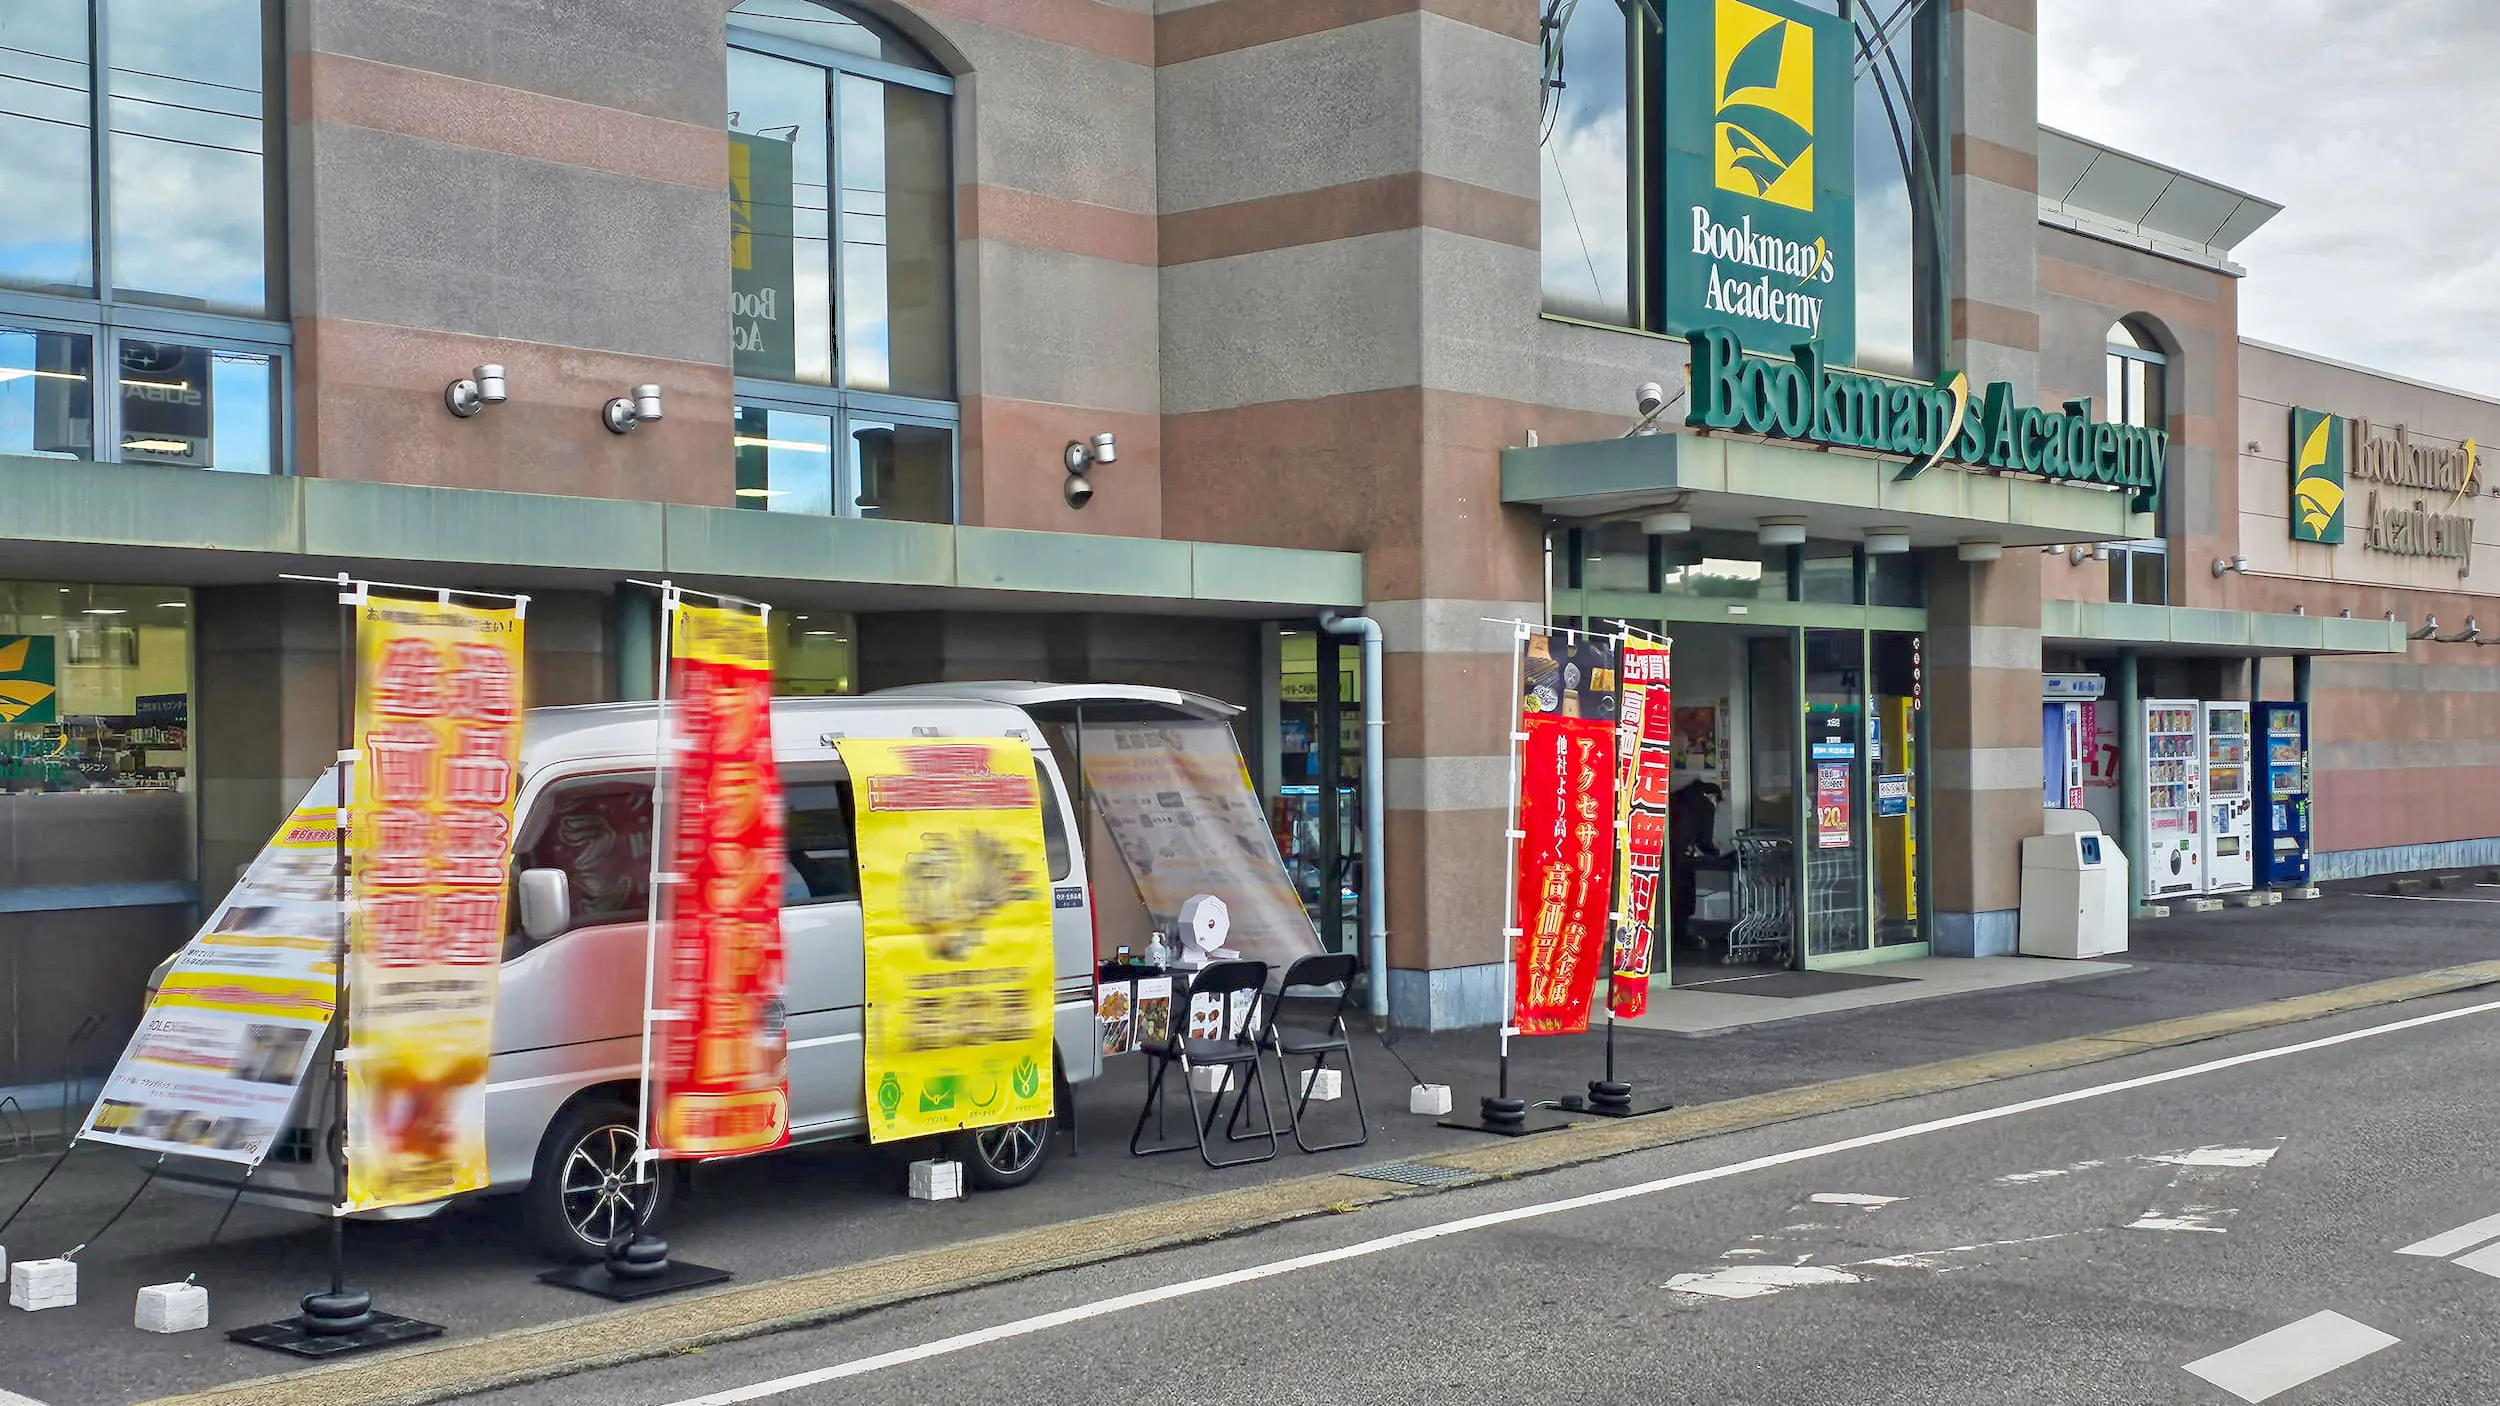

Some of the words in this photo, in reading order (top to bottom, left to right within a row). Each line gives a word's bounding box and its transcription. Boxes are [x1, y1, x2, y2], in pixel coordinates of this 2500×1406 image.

[1691, 205, 1834, 286] Bookman's
[1704, 263, 1823, 339] Academy
[1685, 326, 1985, 482] Bookman's
[1984, 381, 2169, 513] Academy
[2351, 414, 2483, 508] Bookman's
[2364, 488, 2476, 578] Academy
[1553, 735, 1569, 858] 他社より高く
[1548, 736, 1600, 1006] アクセサリー・貴金属
[1528, 862, 1573, 1008] 高価買取
